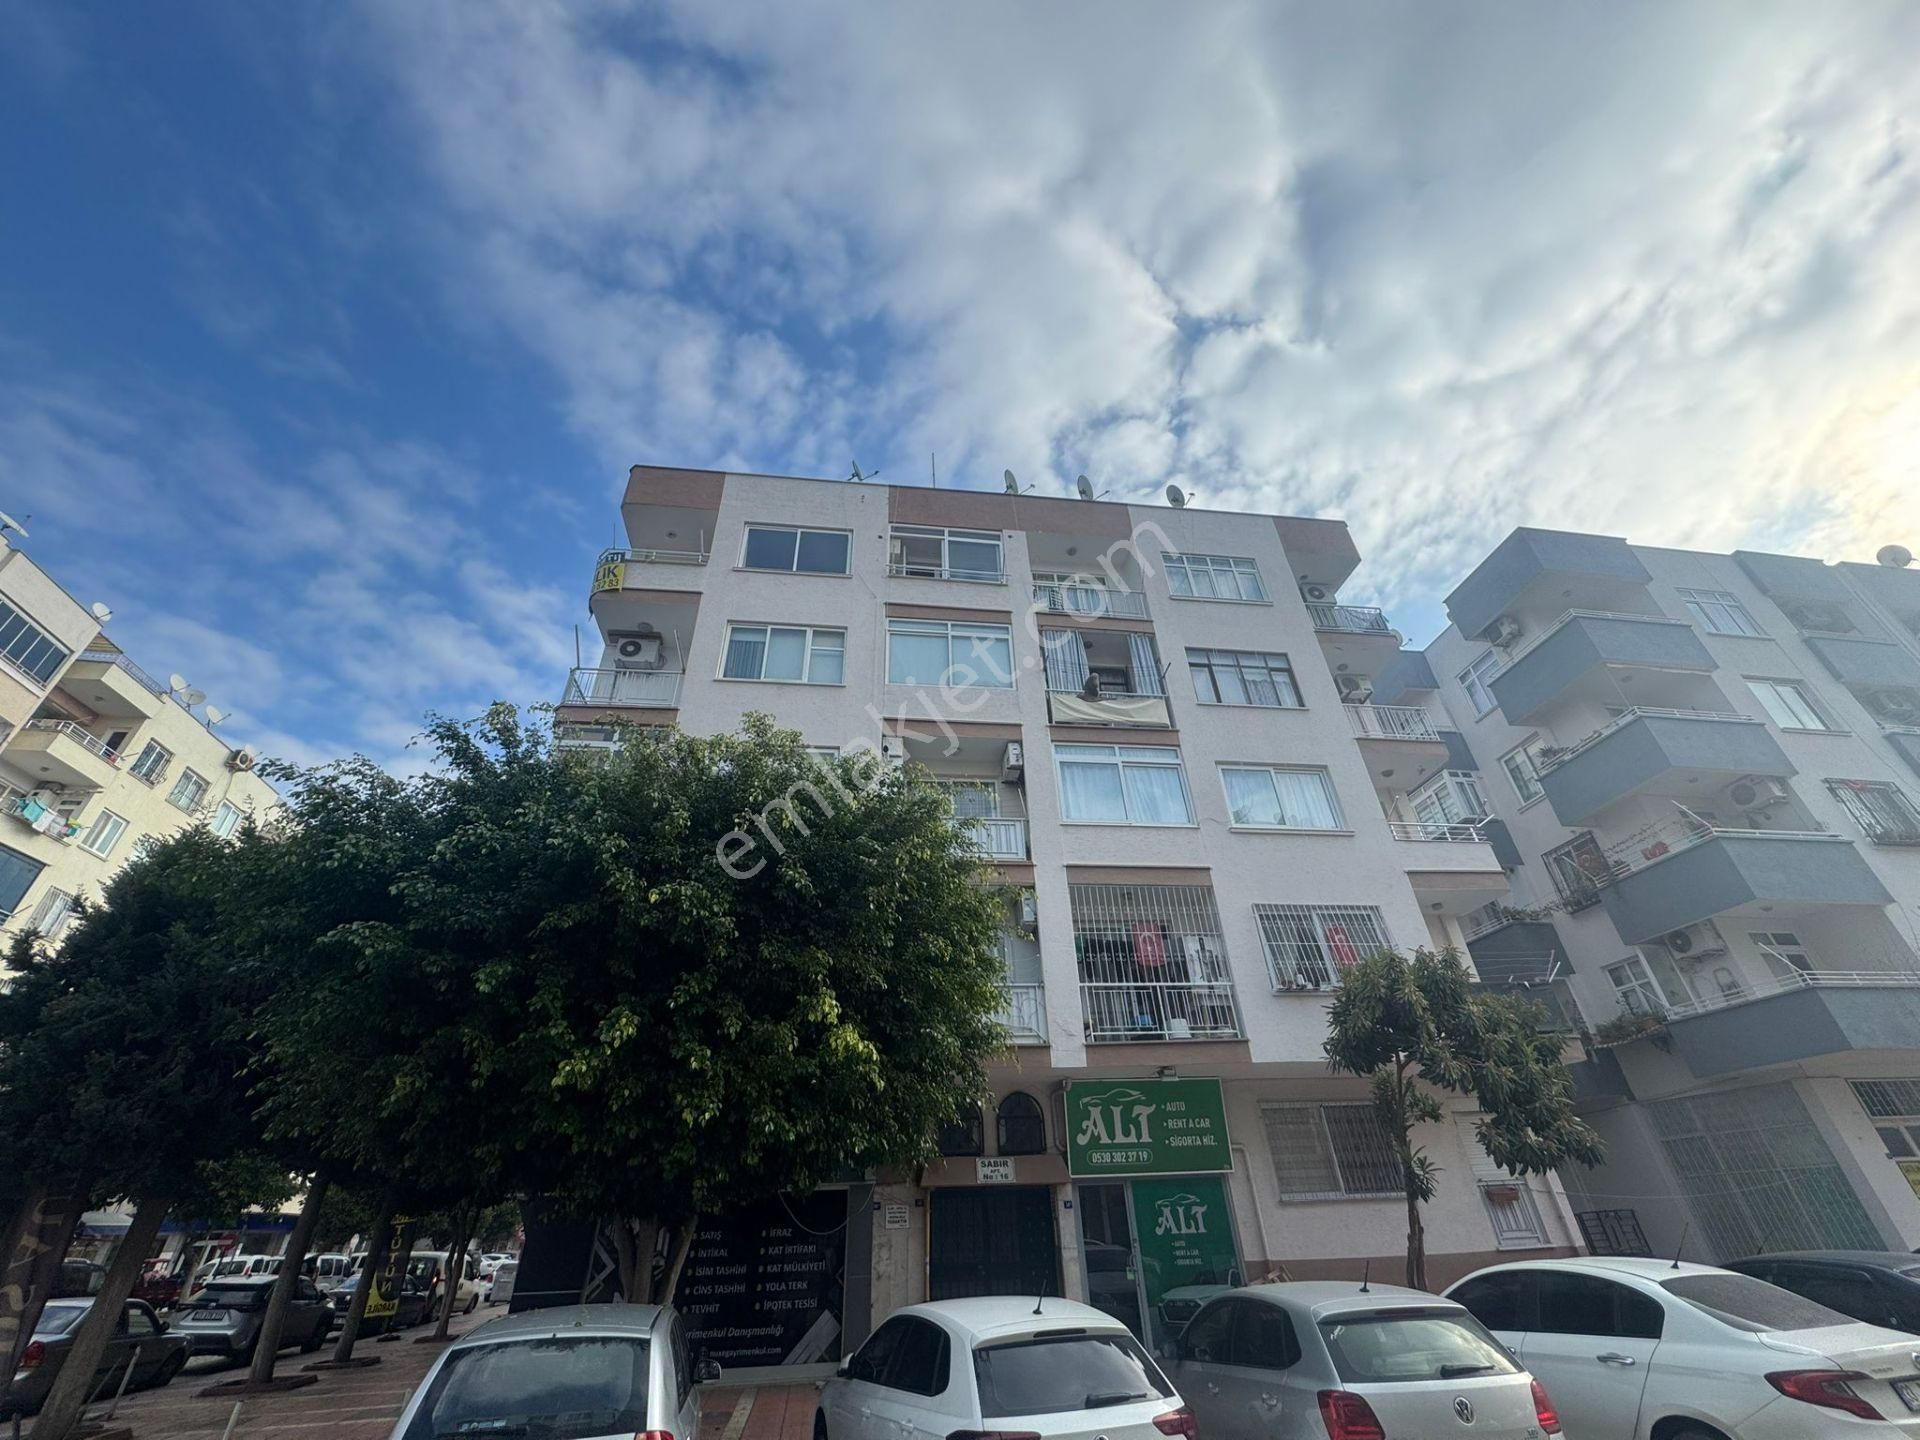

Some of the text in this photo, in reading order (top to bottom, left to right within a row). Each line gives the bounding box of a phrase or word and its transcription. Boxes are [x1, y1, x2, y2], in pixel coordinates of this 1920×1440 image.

[595, 565, 619, 582] LIK
[1166, 1101, 1186, 1112] AUTO
[1167, 1118, 1211, 1129] RENT A CAR
[1169, 1134, 1202, 1147] SİGORTA
[1092, 1152, 1111, 1163] 0530
[980, 1159, 1009, 1168] SABIR
[769, 1228, 793, 1238] İFRAZ
[768, 1246, 783, 1255] KAT
[695, 1264, 747, 1276] İSİM TASHİHİ
[767, 1264, 782, 1273] KAT
[693, 1283, 746, 1295] CİNS TASHİHİ
[765, 1280, 809, 1291] YOLA TERK
